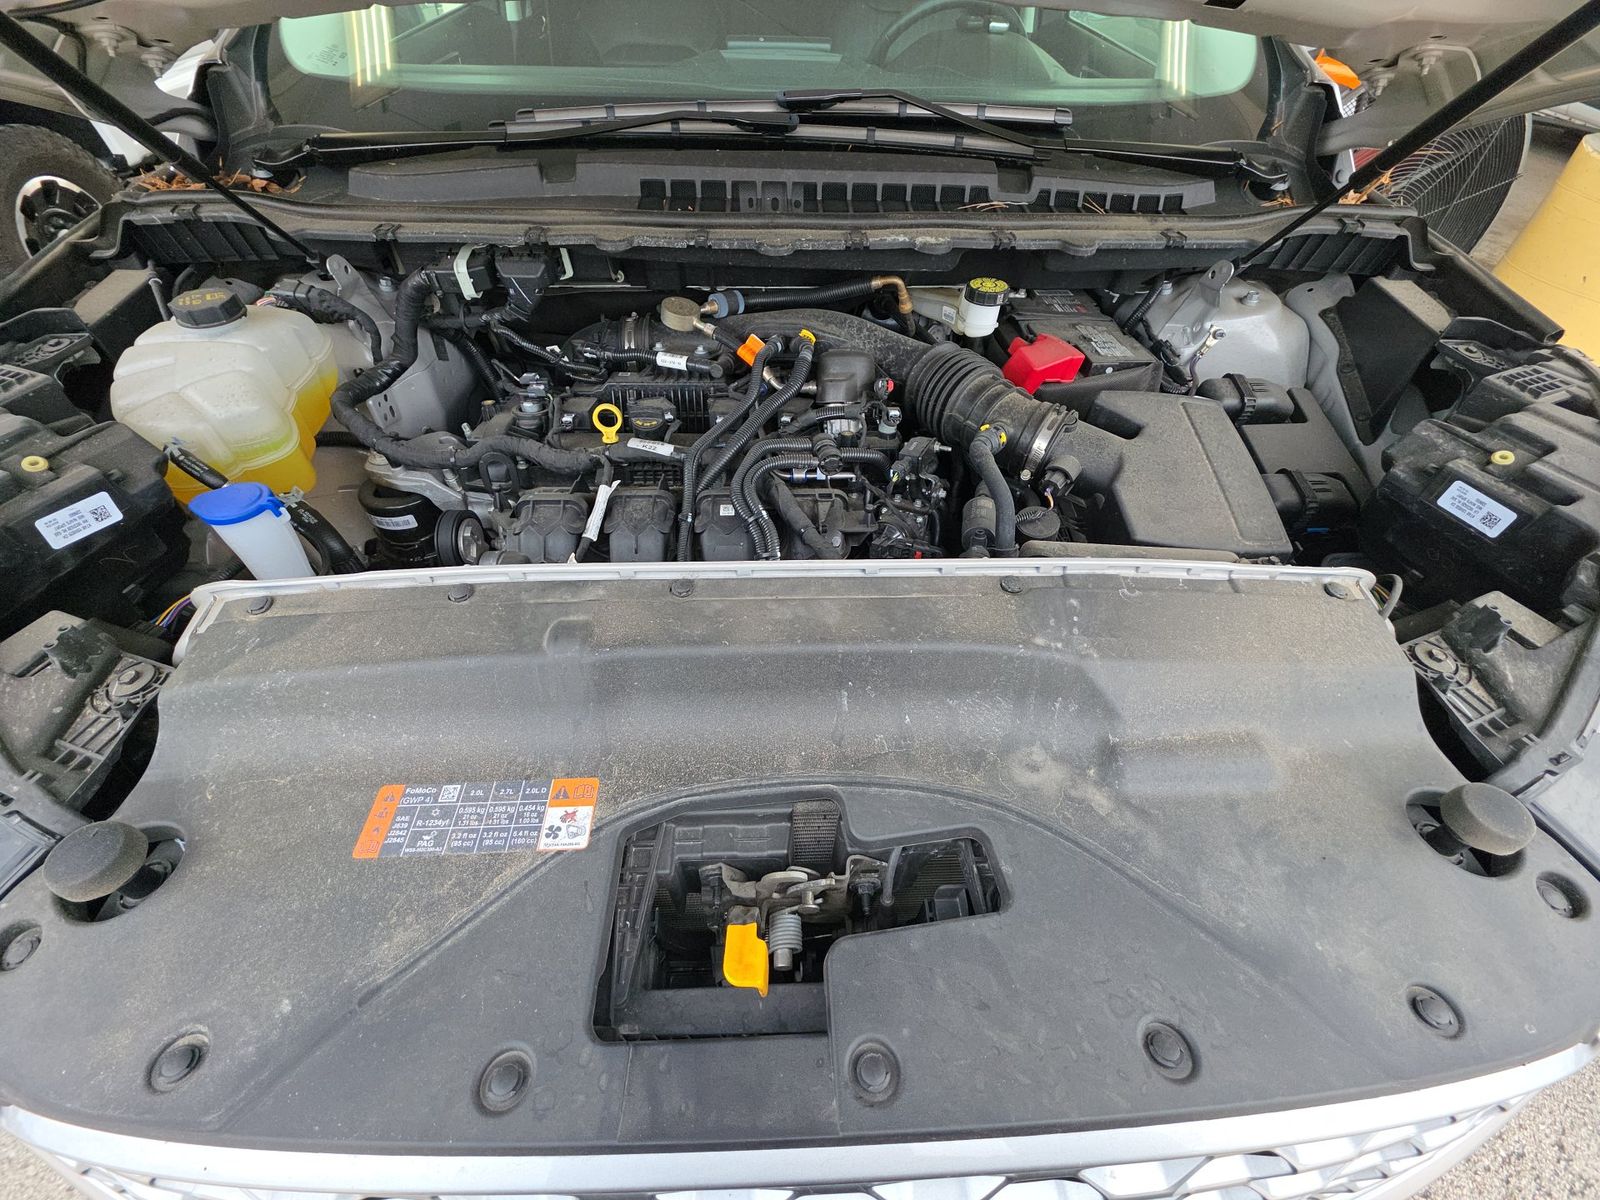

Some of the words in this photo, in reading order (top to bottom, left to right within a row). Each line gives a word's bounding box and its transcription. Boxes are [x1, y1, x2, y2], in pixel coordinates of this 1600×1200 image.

[400, 796, 424, 804] (GWP
[425, 796, 434, 804] 4)
[476, 806, 485, 814] kg
[506, 806, 516, 814] kg
[536, 804, 545, 812] kg
[416, 819, 450, 828] R-1234yf
[462, 840, 474, 848] cc)
[494, 838, 505, 846] cc)
